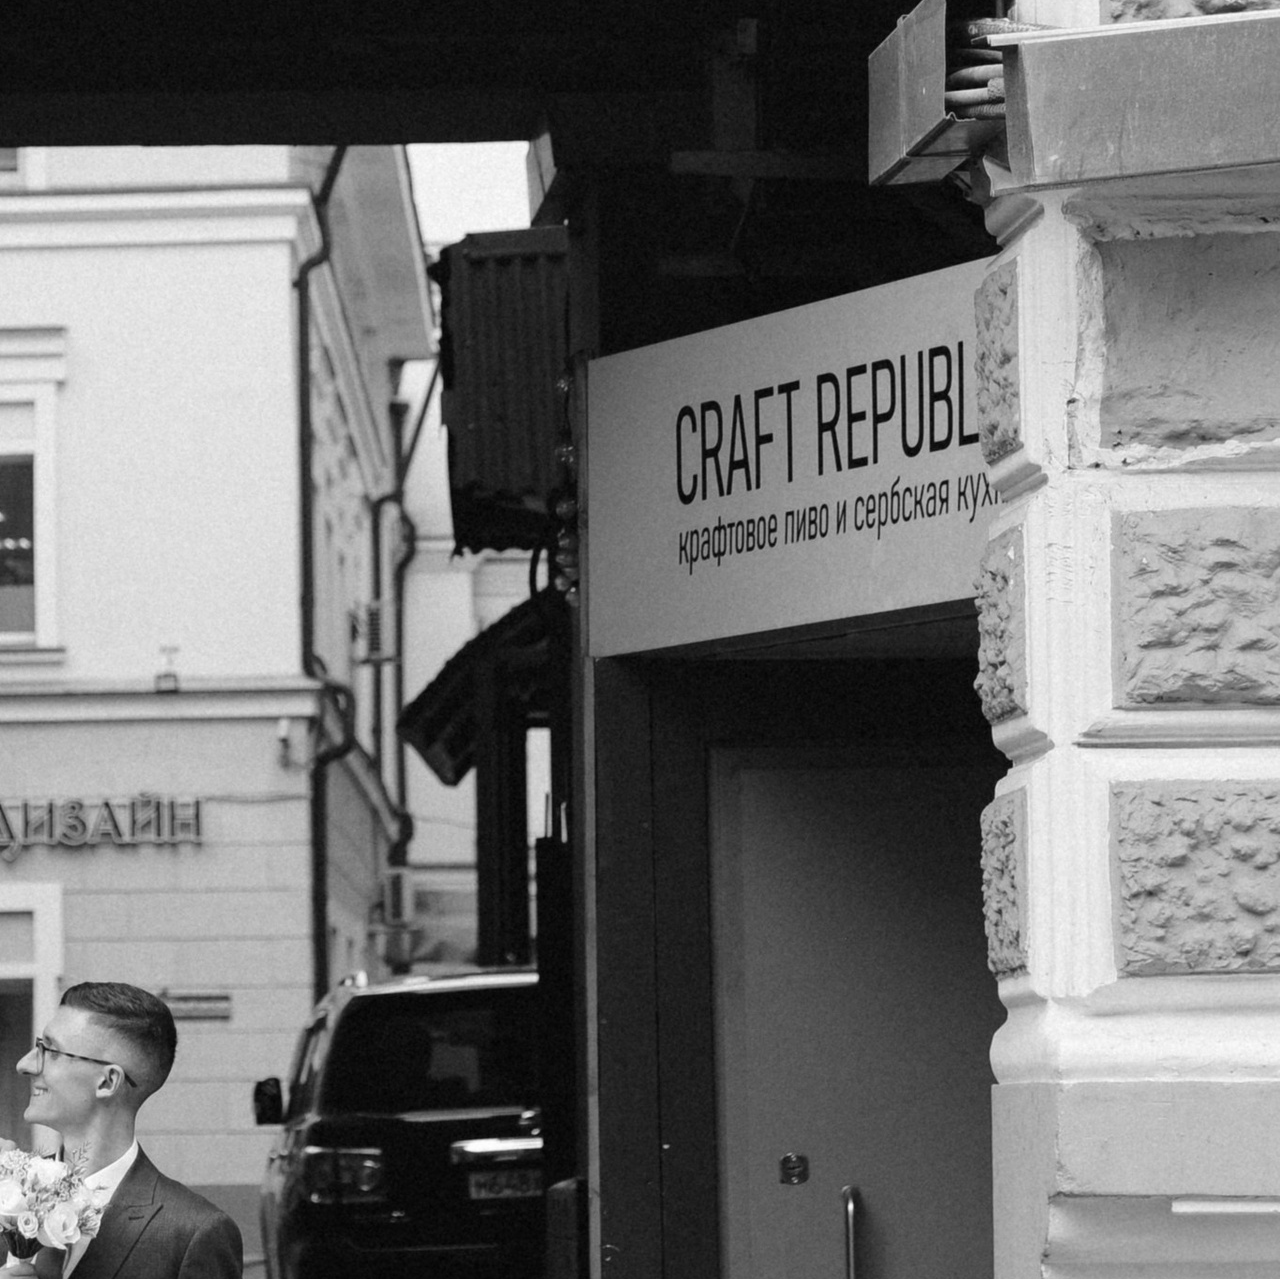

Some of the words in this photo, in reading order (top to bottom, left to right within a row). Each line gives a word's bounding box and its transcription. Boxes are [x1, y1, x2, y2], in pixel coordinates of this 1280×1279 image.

[675, 379, 800, 505] CRAFT
[817, 340, 980, 476] REPUBL
[678, 515, 778, 576] крафтовое
[784, 499, 829, 545] пиво
[837, 499, 848, 535] и
[854, 475, 950, 540] сербская
